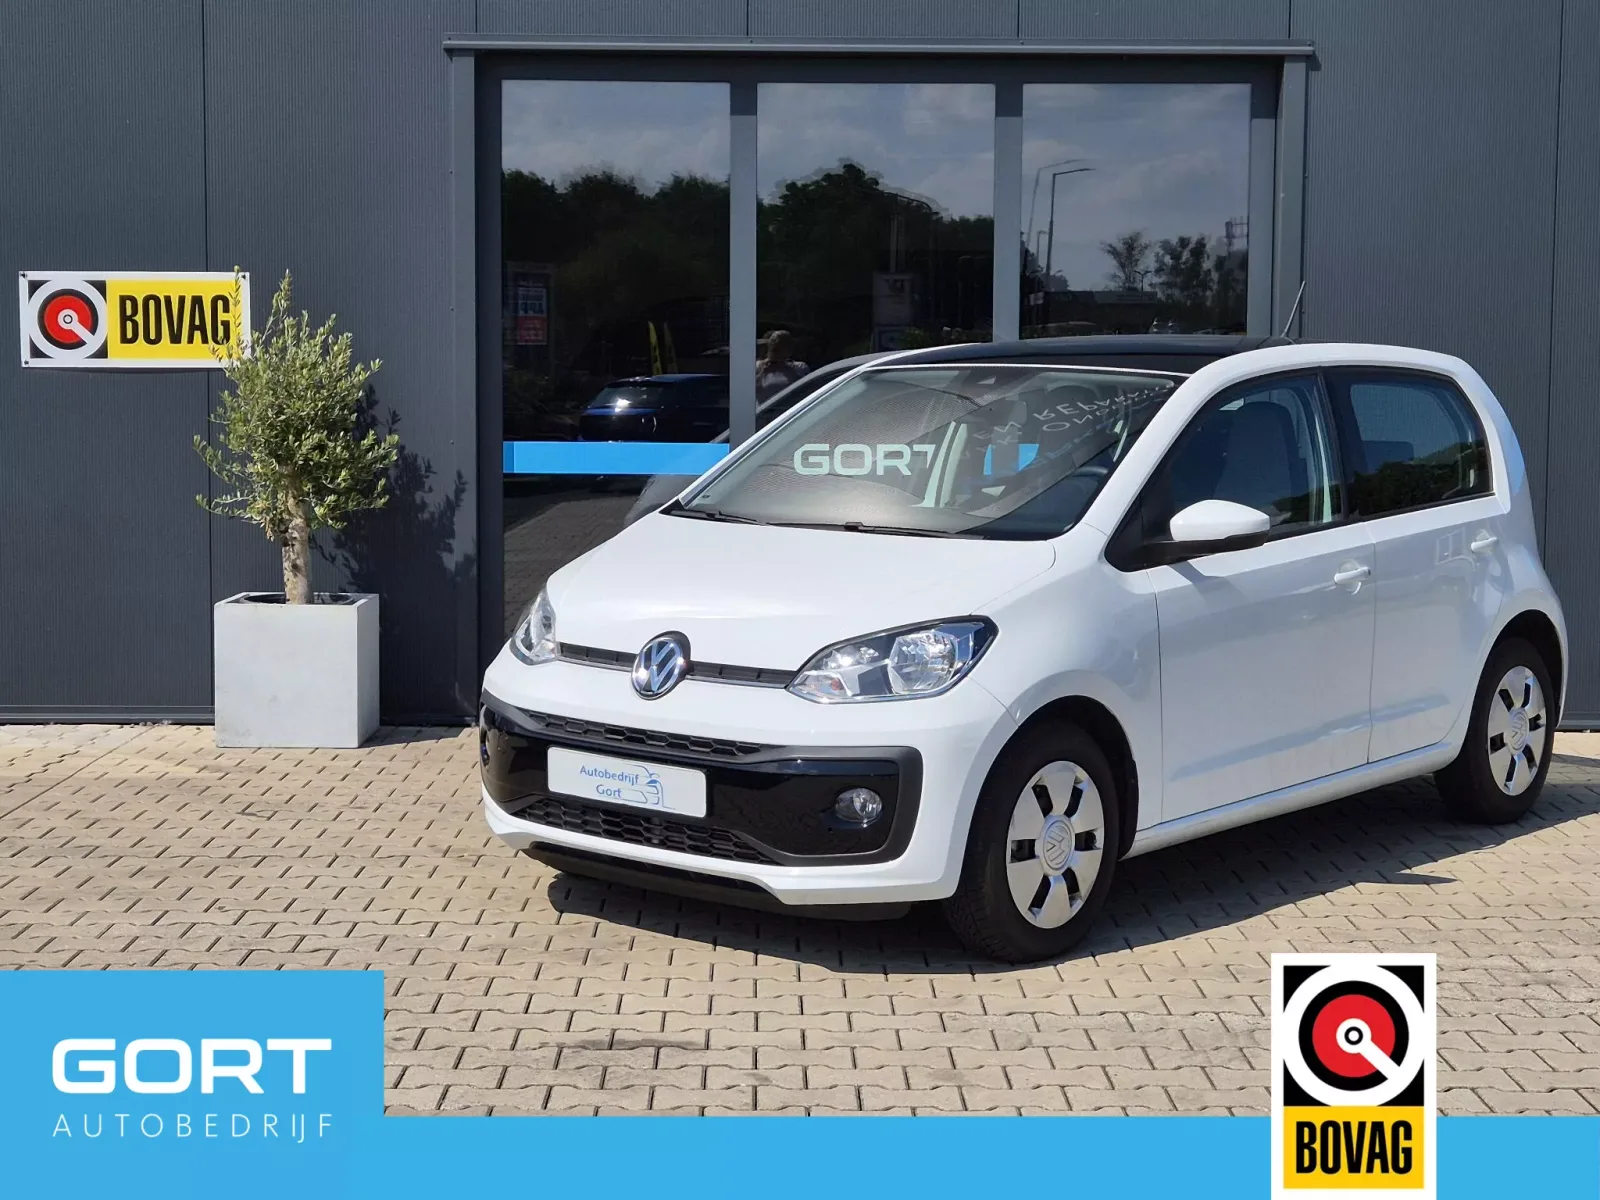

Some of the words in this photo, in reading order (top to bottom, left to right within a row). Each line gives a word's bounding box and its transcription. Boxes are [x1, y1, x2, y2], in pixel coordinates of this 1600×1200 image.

[119, 294, 231, 346] BOVAG
[579, 765, 639, 786] Autobedrijf
[596, 784, 622, 799] Gort
